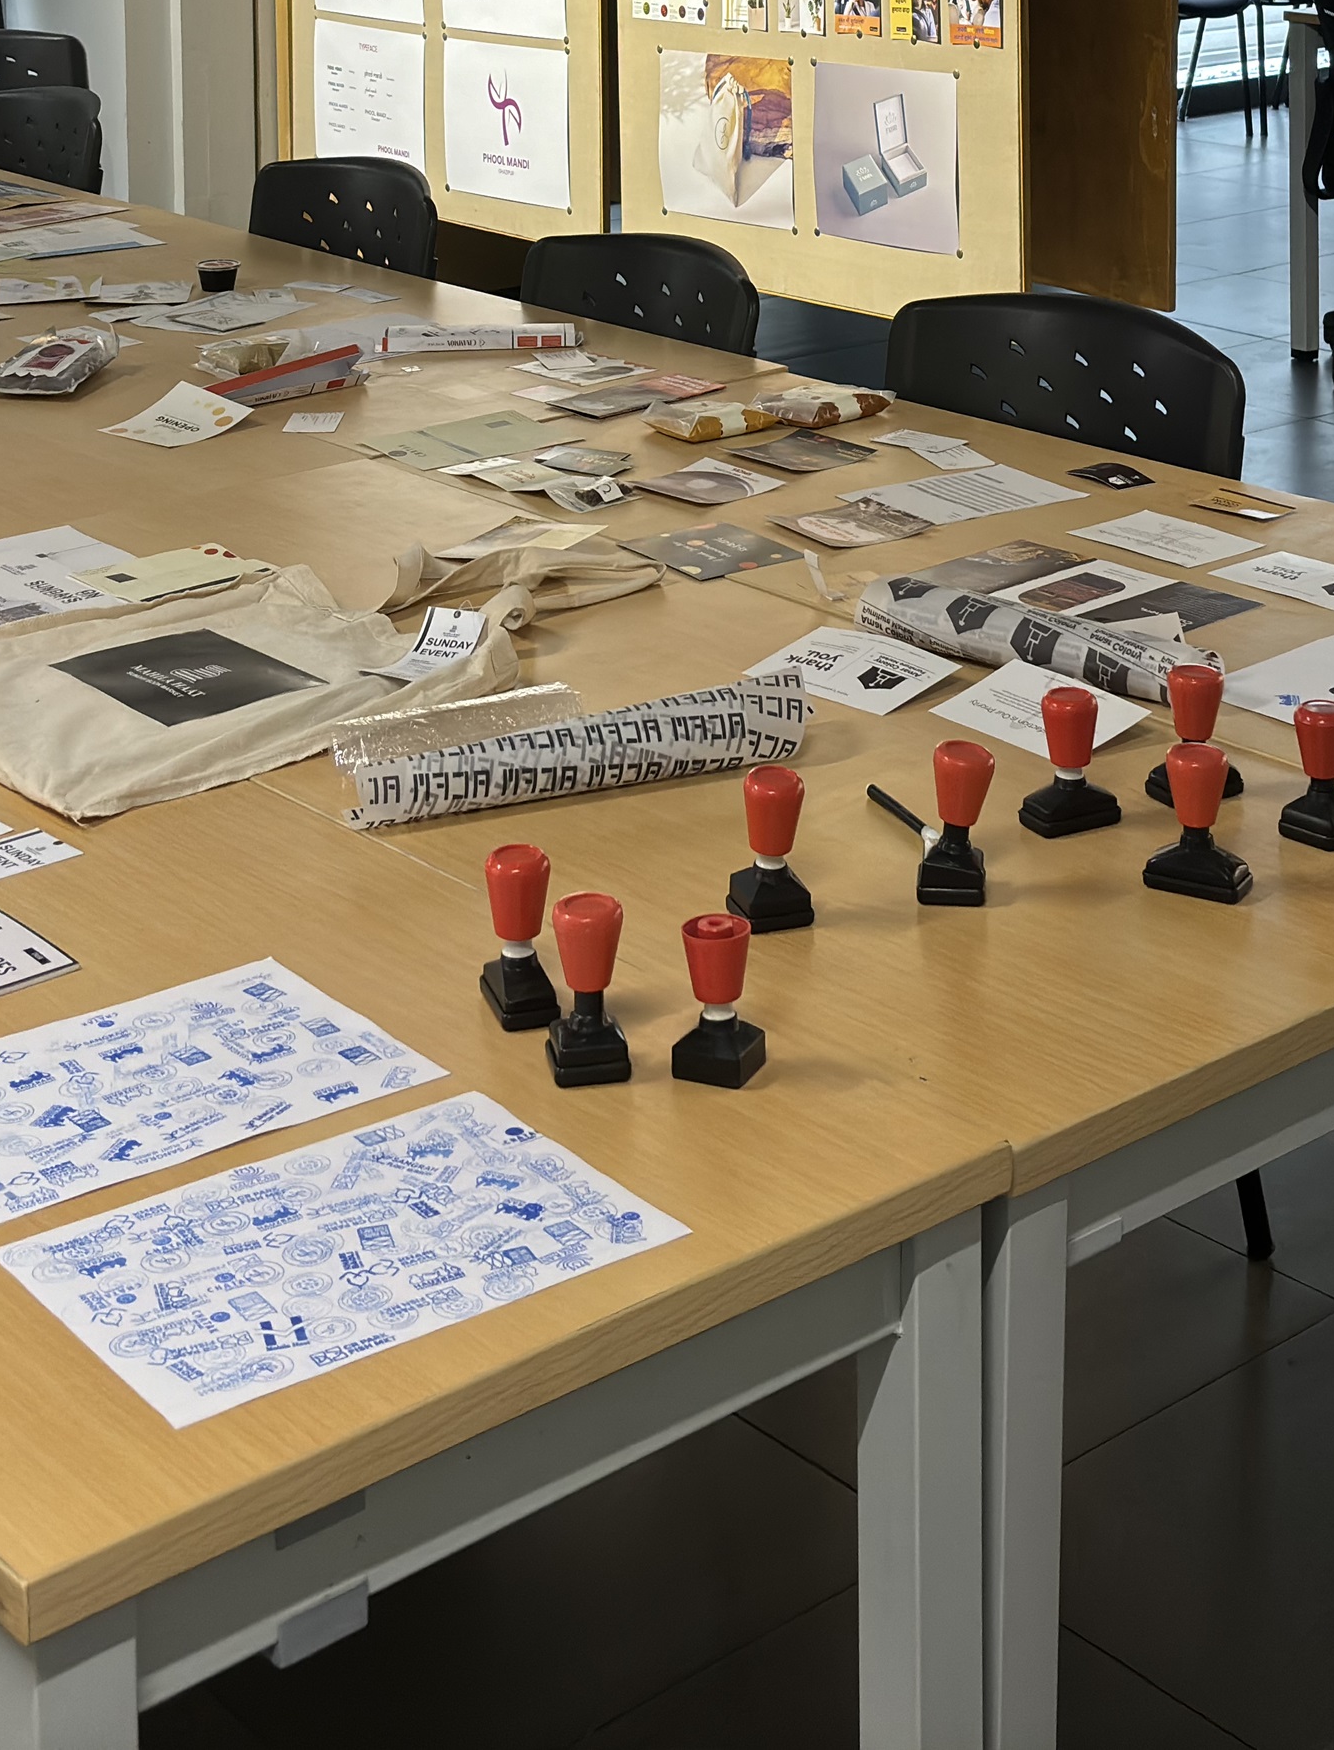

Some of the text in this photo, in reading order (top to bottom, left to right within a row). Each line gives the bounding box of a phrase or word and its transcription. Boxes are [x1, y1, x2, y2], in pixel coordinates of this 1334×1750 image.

[482, 153, 530, 170] PHOOL MANDI
[155, 415, 200, 432] OPENING
[426, 637, 473, 650] SUNDAY
[419, 648, 459, 659] EVENT
[785, 654, 834, 672] thank
[0, 844, 45, 866] SUNDAY
